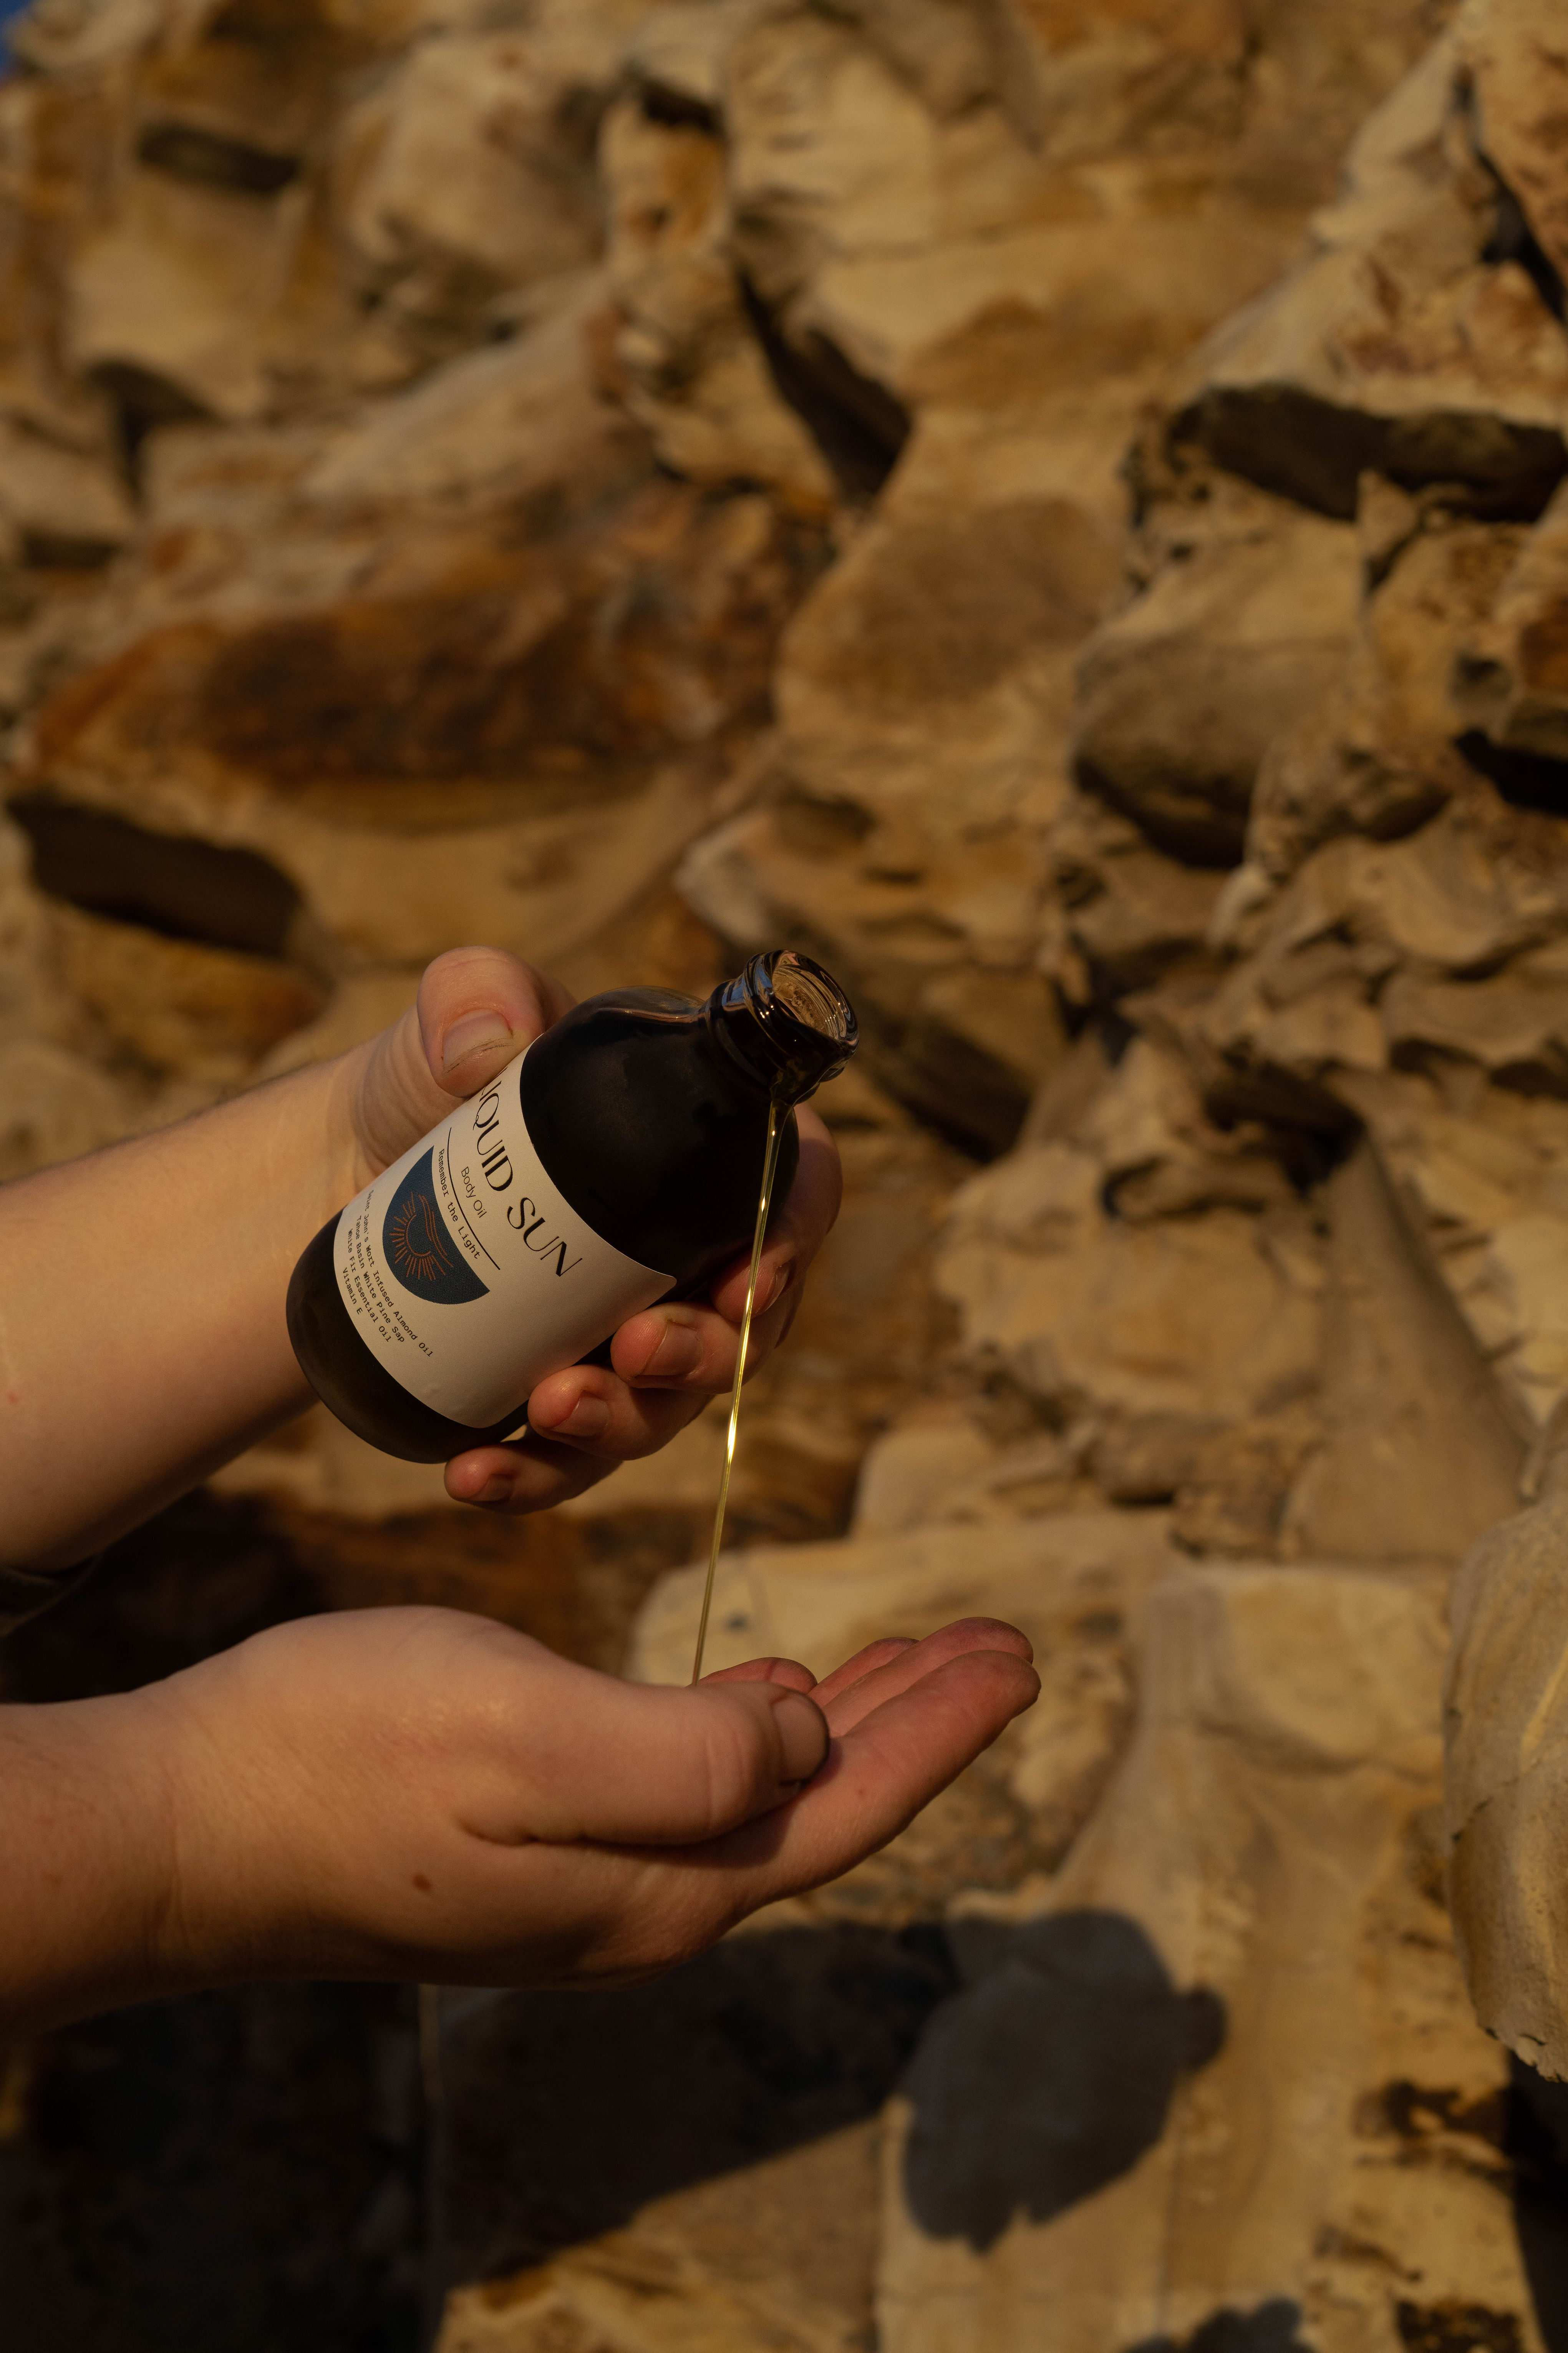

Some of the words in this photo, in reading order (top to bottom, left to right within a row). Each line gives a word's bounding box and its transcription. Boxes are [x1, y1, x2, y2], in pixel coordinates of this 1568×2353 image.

[438, 1148, 449, 1197] Remember
[447, 1201, 458, 1222] the
[458, 1226, 481, 1259] Light
[461, 1166, 476, 1198] Body
[473, 1200, 487, 1218] Oil
[507, 1197, 583, 1277] SUN
[343, 1267, 357, 1304] Vitamin
[354, 1276, 378, 1323] Essential
[379, 1326, 392, 1342] Oil
[356, 1242, 365, 1269] Basin
[363, 1271, 376, 1299] White
[376, 1302, 391, 1324] Pine
[392, 1326, 404, 1342] Sap
[366, 1245, 375, 1267] Wort
[373, 1270, 394, 1307] Infused
[393, 1311, 418, 1340] Almond
[419, 1342, 433, 1357] Oil
